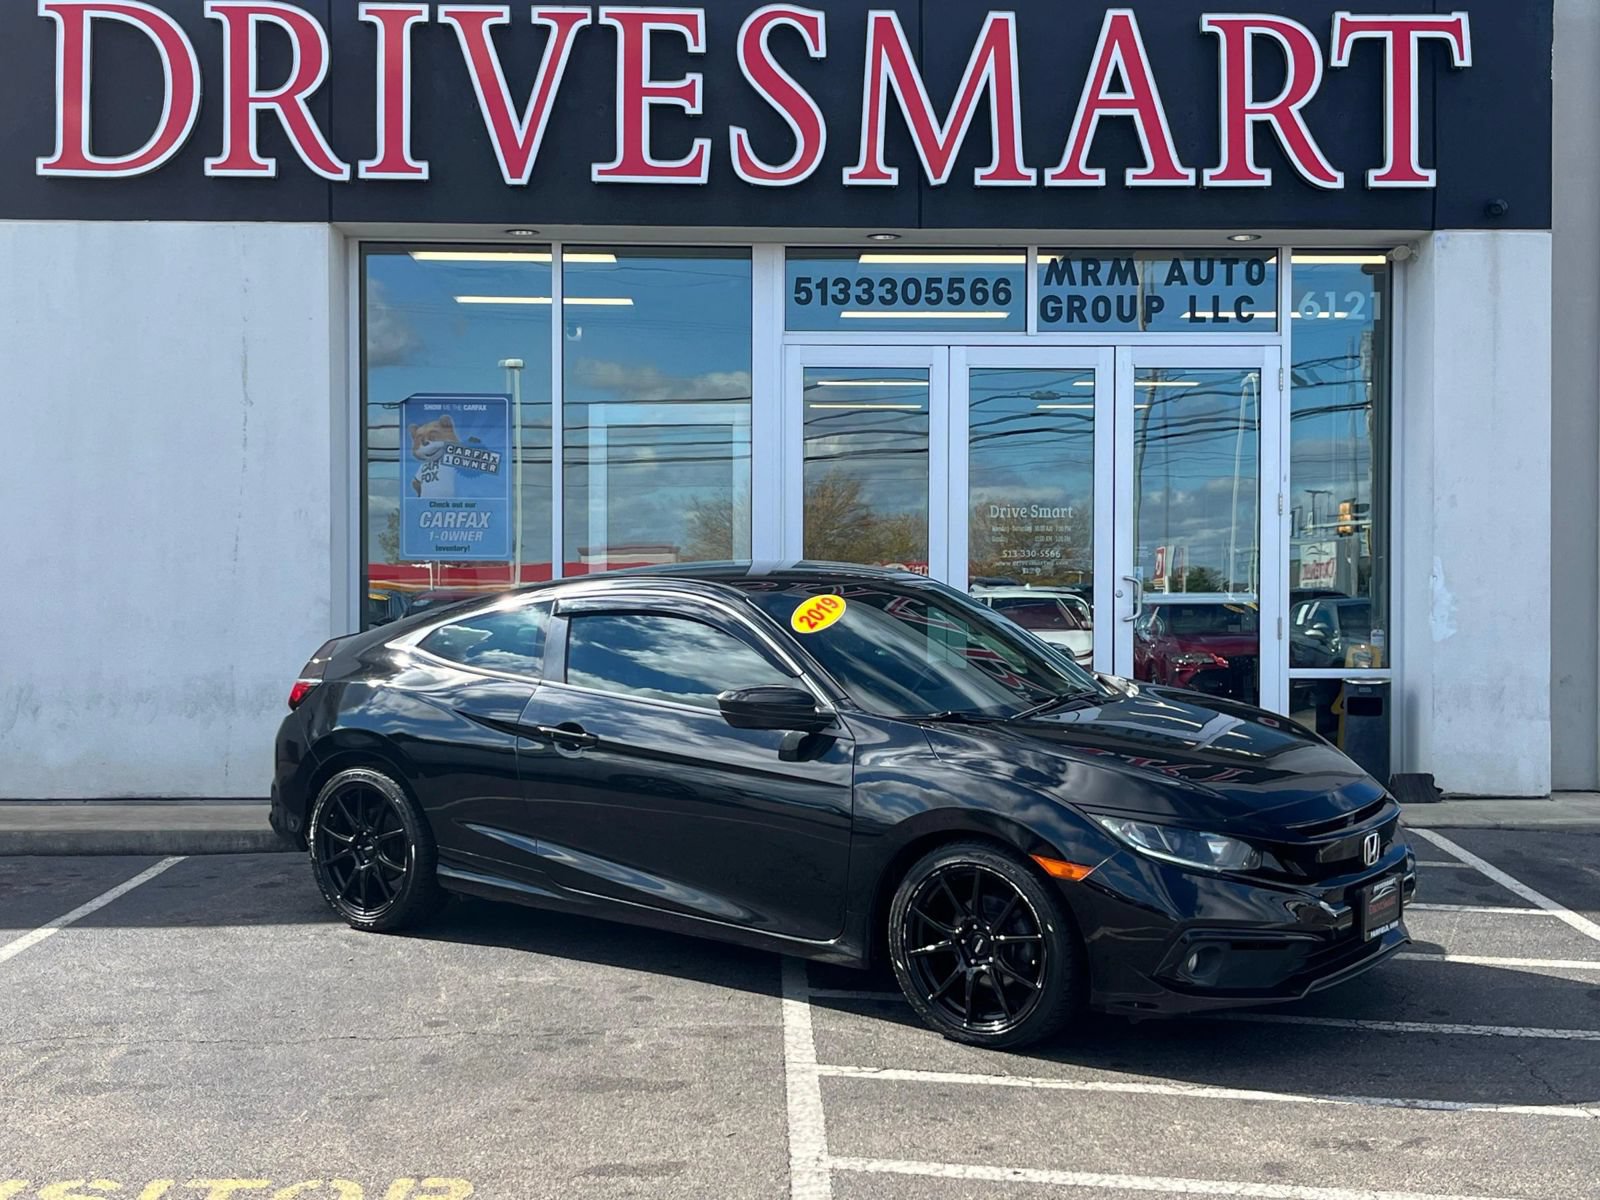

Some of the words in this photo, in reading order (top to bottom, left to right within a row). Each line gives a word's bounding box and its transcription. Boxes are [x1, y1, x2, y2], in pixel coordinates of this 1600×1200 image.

[36, 0, 1473, 189] DRIVESMART
[1043, 257, 1140, 287] MRM
[1164, 257, 1267, 287] AUTO
[793, 277, 1013, 306] 5133305566
[1039, 294, 1166, 324] GROUP
[1188, 294, 1256, 324] LLC
[1298, 291, 1381, 321] 6121
[446, 444, 499, 464] CARFAX
[421, 470, 440, 483] FOX
[429, 500, 450, 508] Check
[990, 504, 1028, 518] Drive
[1030, 504, 1074, 518] Smart
[419, 511, 491, 529] CARFAX
[428, 530, 484, 542] 1-OWNER
[435, 544, 471, 553] Inventory!
[1002, 549, 1061, 558] 513-330-5566
[798, 597, 839, 630] 2019
